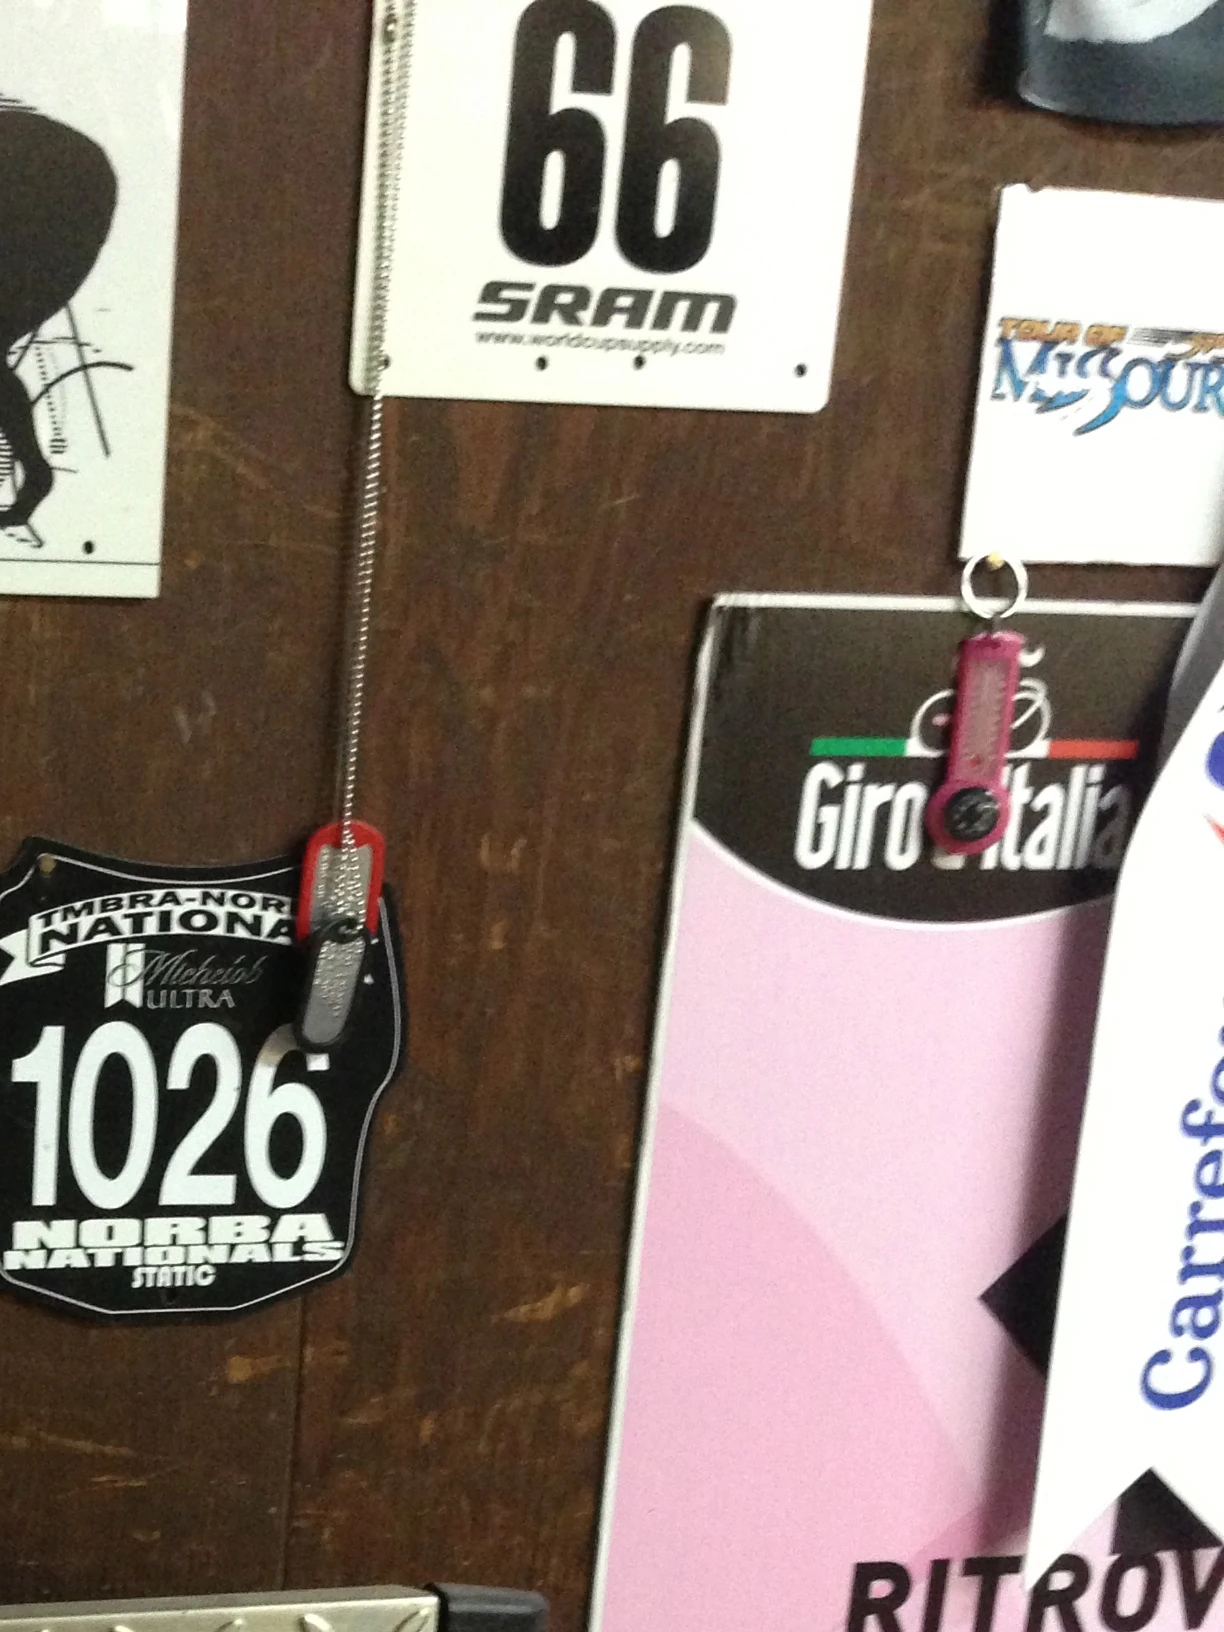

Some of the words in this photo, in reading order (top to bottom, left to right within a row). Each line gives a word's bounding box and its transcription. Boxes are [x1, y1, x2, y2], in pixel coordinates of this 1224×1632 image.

[499, 0, 733, 274] 66
[472, 280, 737, 334] SRAM
[475, 332, 726, 356] www.worldcupsupply.com
[999, 317, 1080, 343] TOUR
[1085, 323, 1126, 347] OF
[794, 761, 926, 870] Giro
[107, 949, 268, 988] Michelob
[145, 987, 236, 1010] ULTRA
[11, 1020, 328, 1209] 1026
[12, 1213, 335, 1250] NORBA
[1139, 1045, 1224, 1413] Carref
[2, 1241, 346, 1270] NATIONALS
